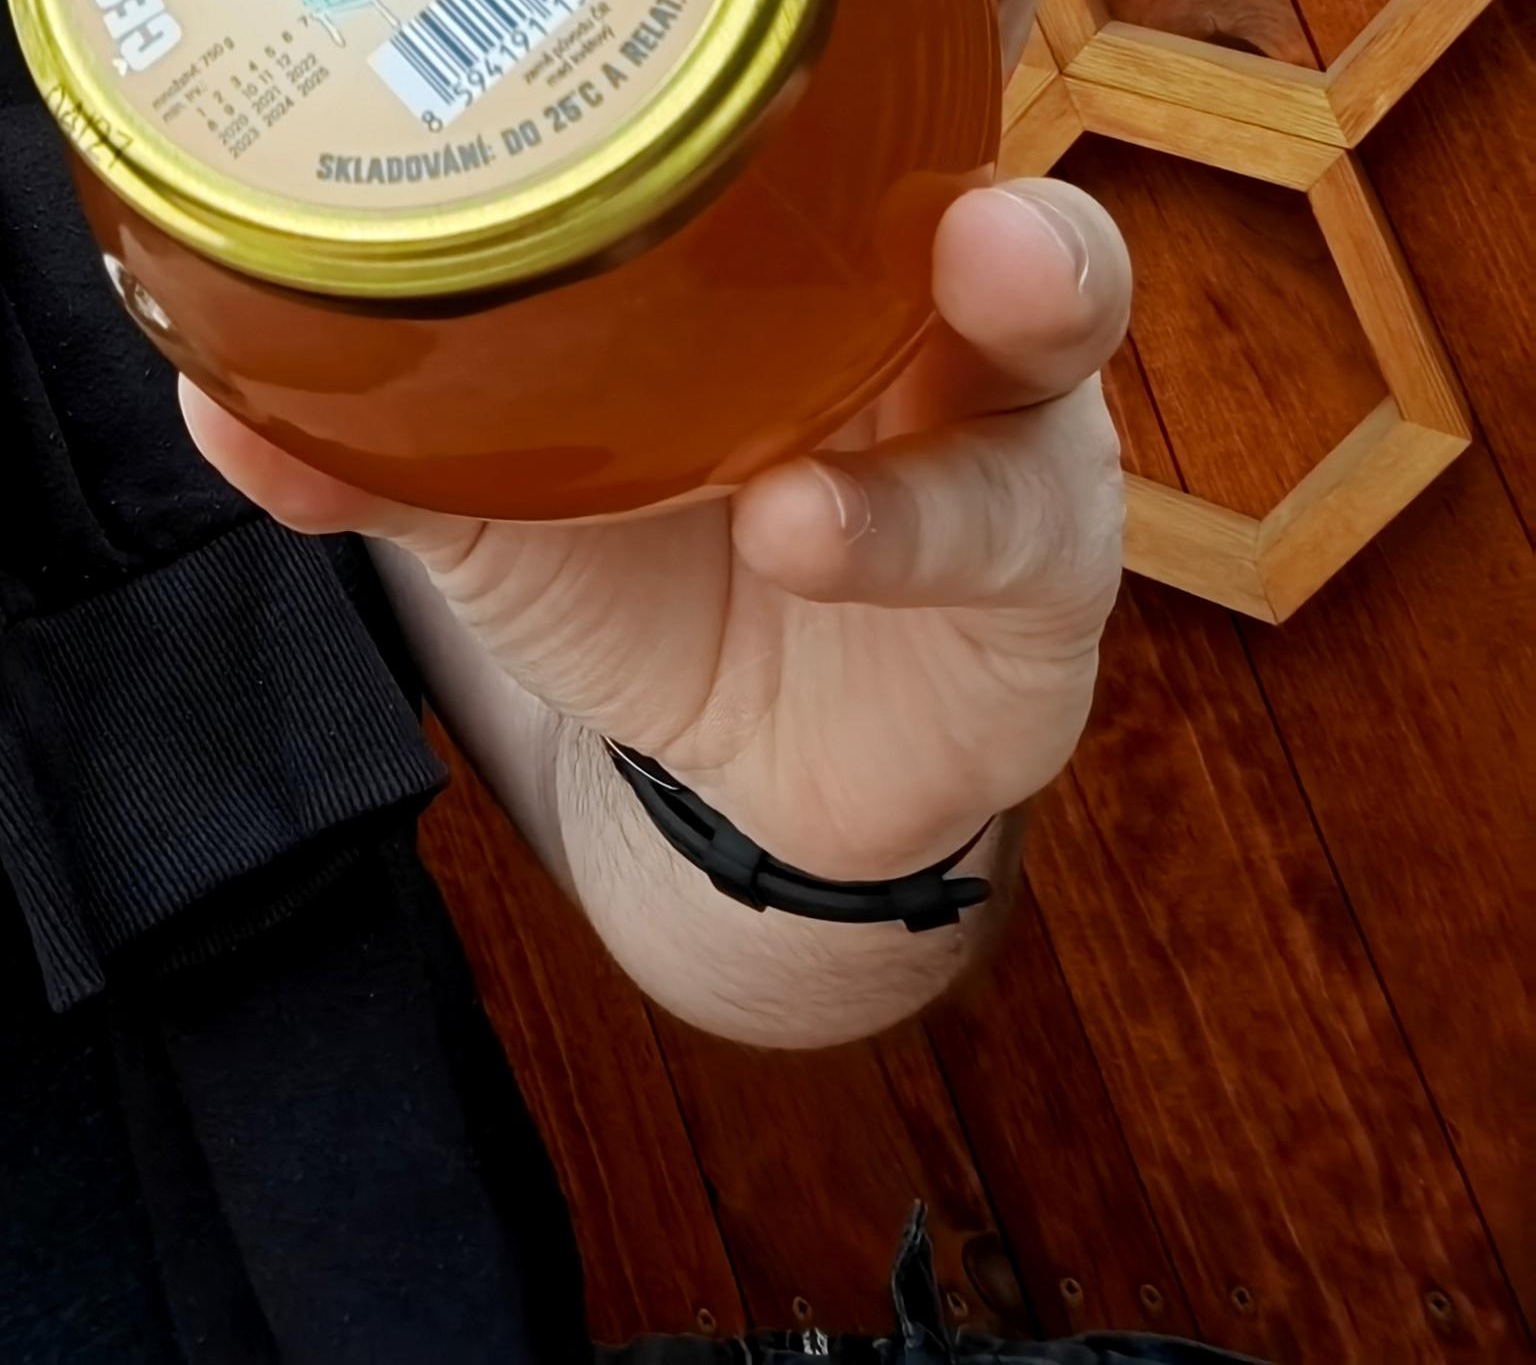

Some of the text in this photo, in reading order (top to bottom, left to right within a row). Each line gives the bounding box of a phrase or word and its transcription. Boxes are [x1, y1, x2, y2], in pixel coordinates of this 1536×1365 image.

[218, 53, 316, 146] 2020 2021 2022
[421, 110, 444, 133] 8
[452, 17, 548, 109] 594191
[501, 119, 542, 156] DO
[601, 62, 629, 89] A
